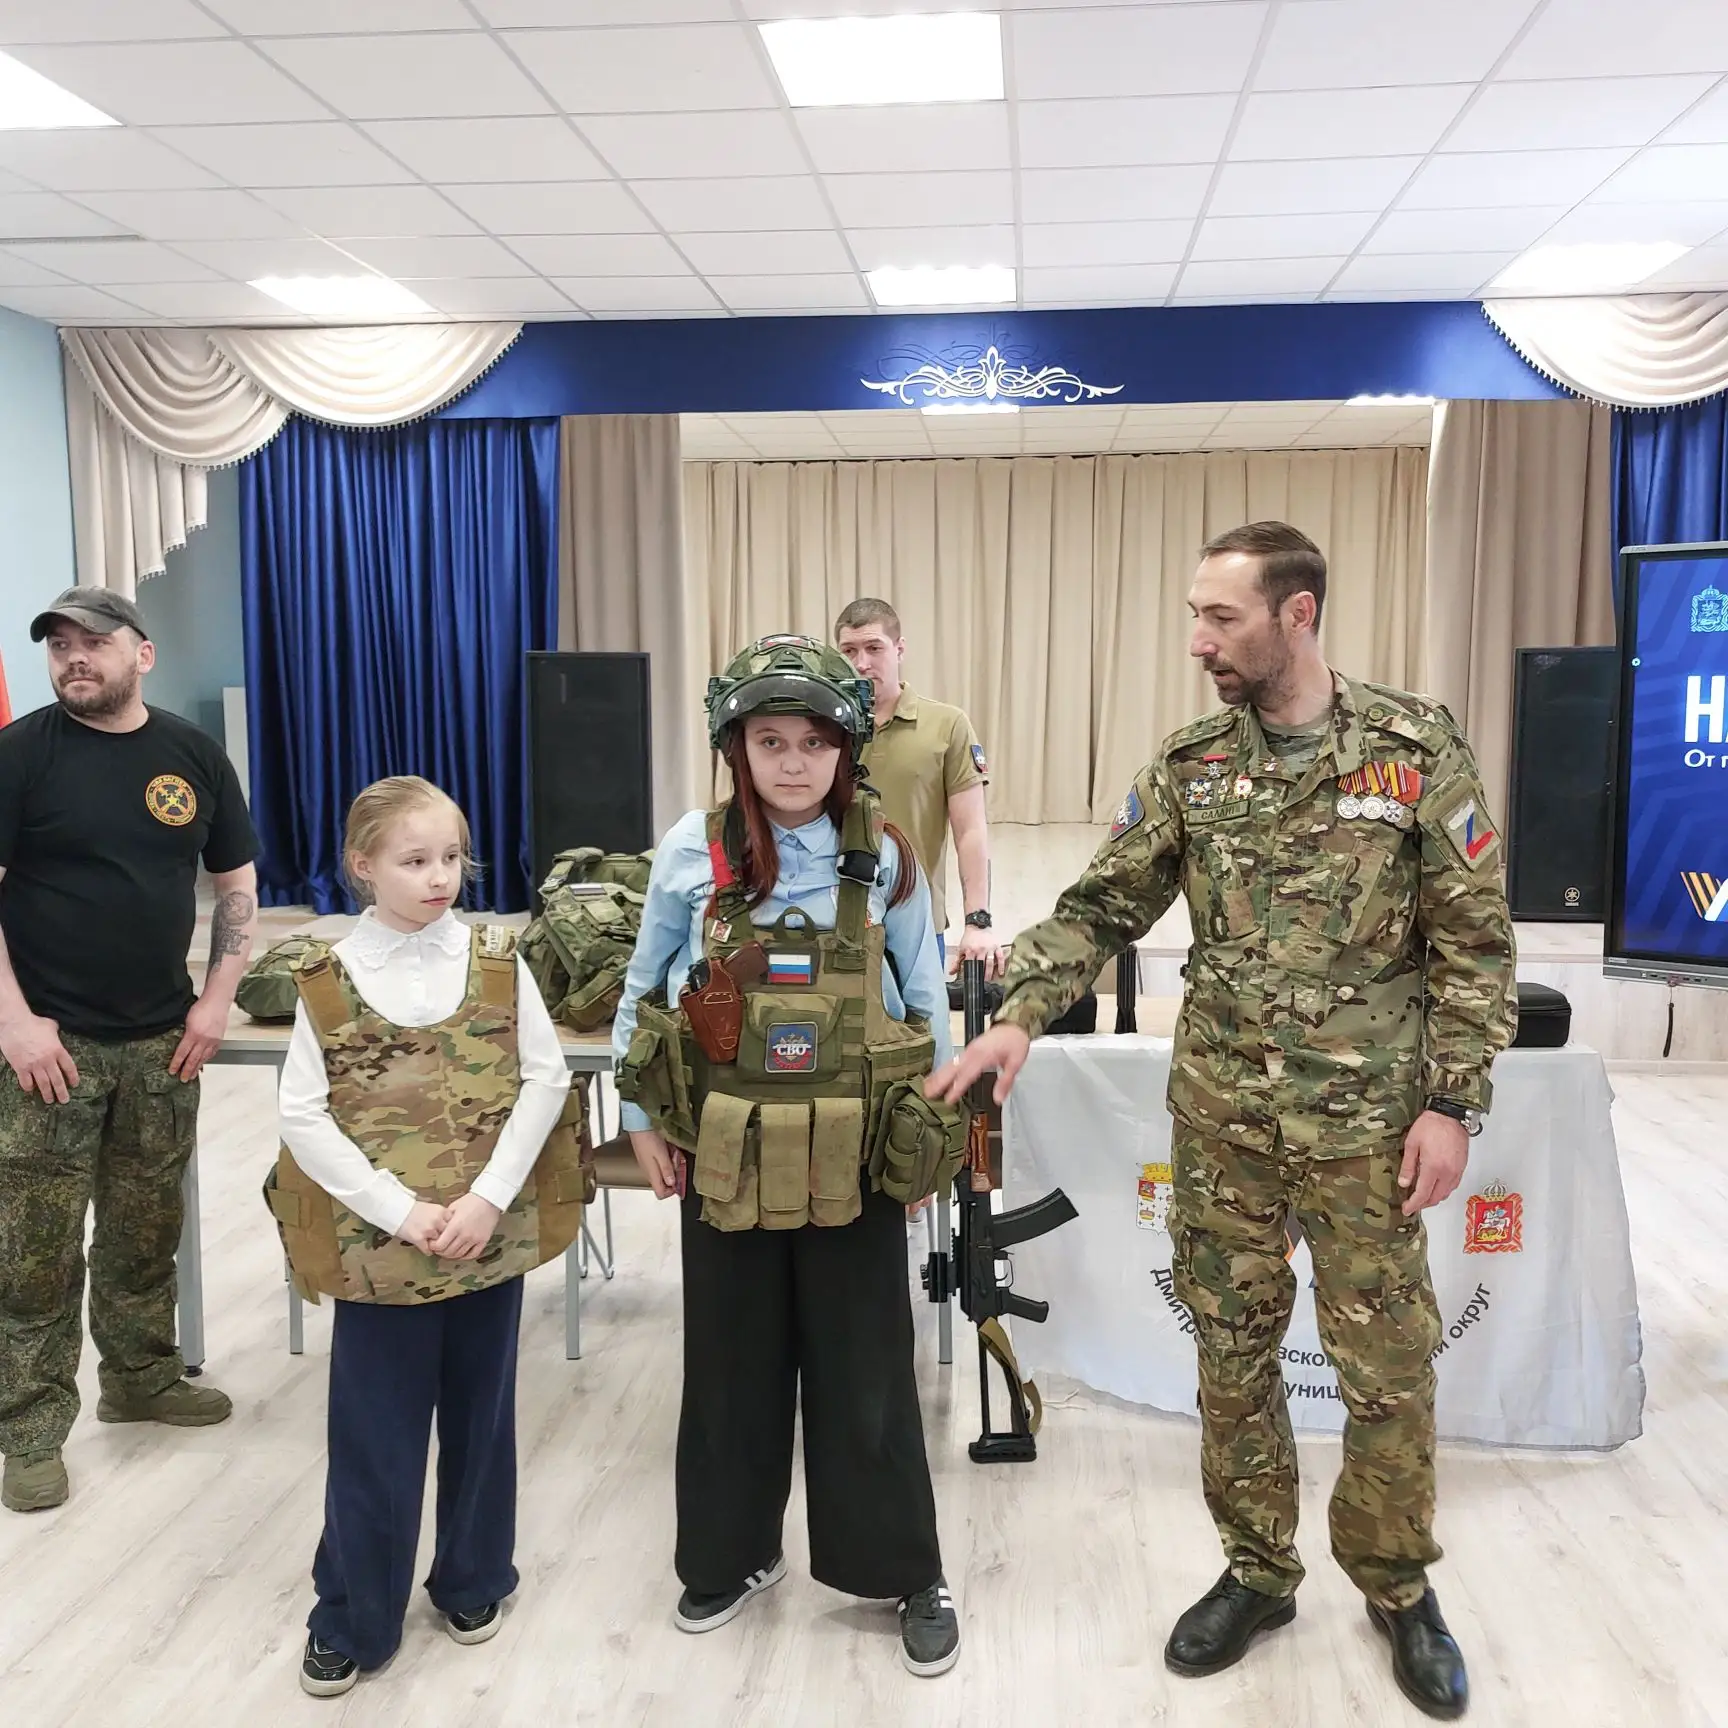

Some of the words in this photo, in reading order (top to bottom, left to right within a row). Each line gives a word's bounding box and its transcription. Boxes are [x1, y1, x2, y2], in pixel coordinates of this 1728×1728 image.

[1685, 675, 1728, 743] Н
[1684, 748, 1716, 768] От
[1149, 1268, 1199, 1343] Дмитр
[1449, 1282, 1491, 1339] округ
[1277, 1346, 1332, 1367] вско
